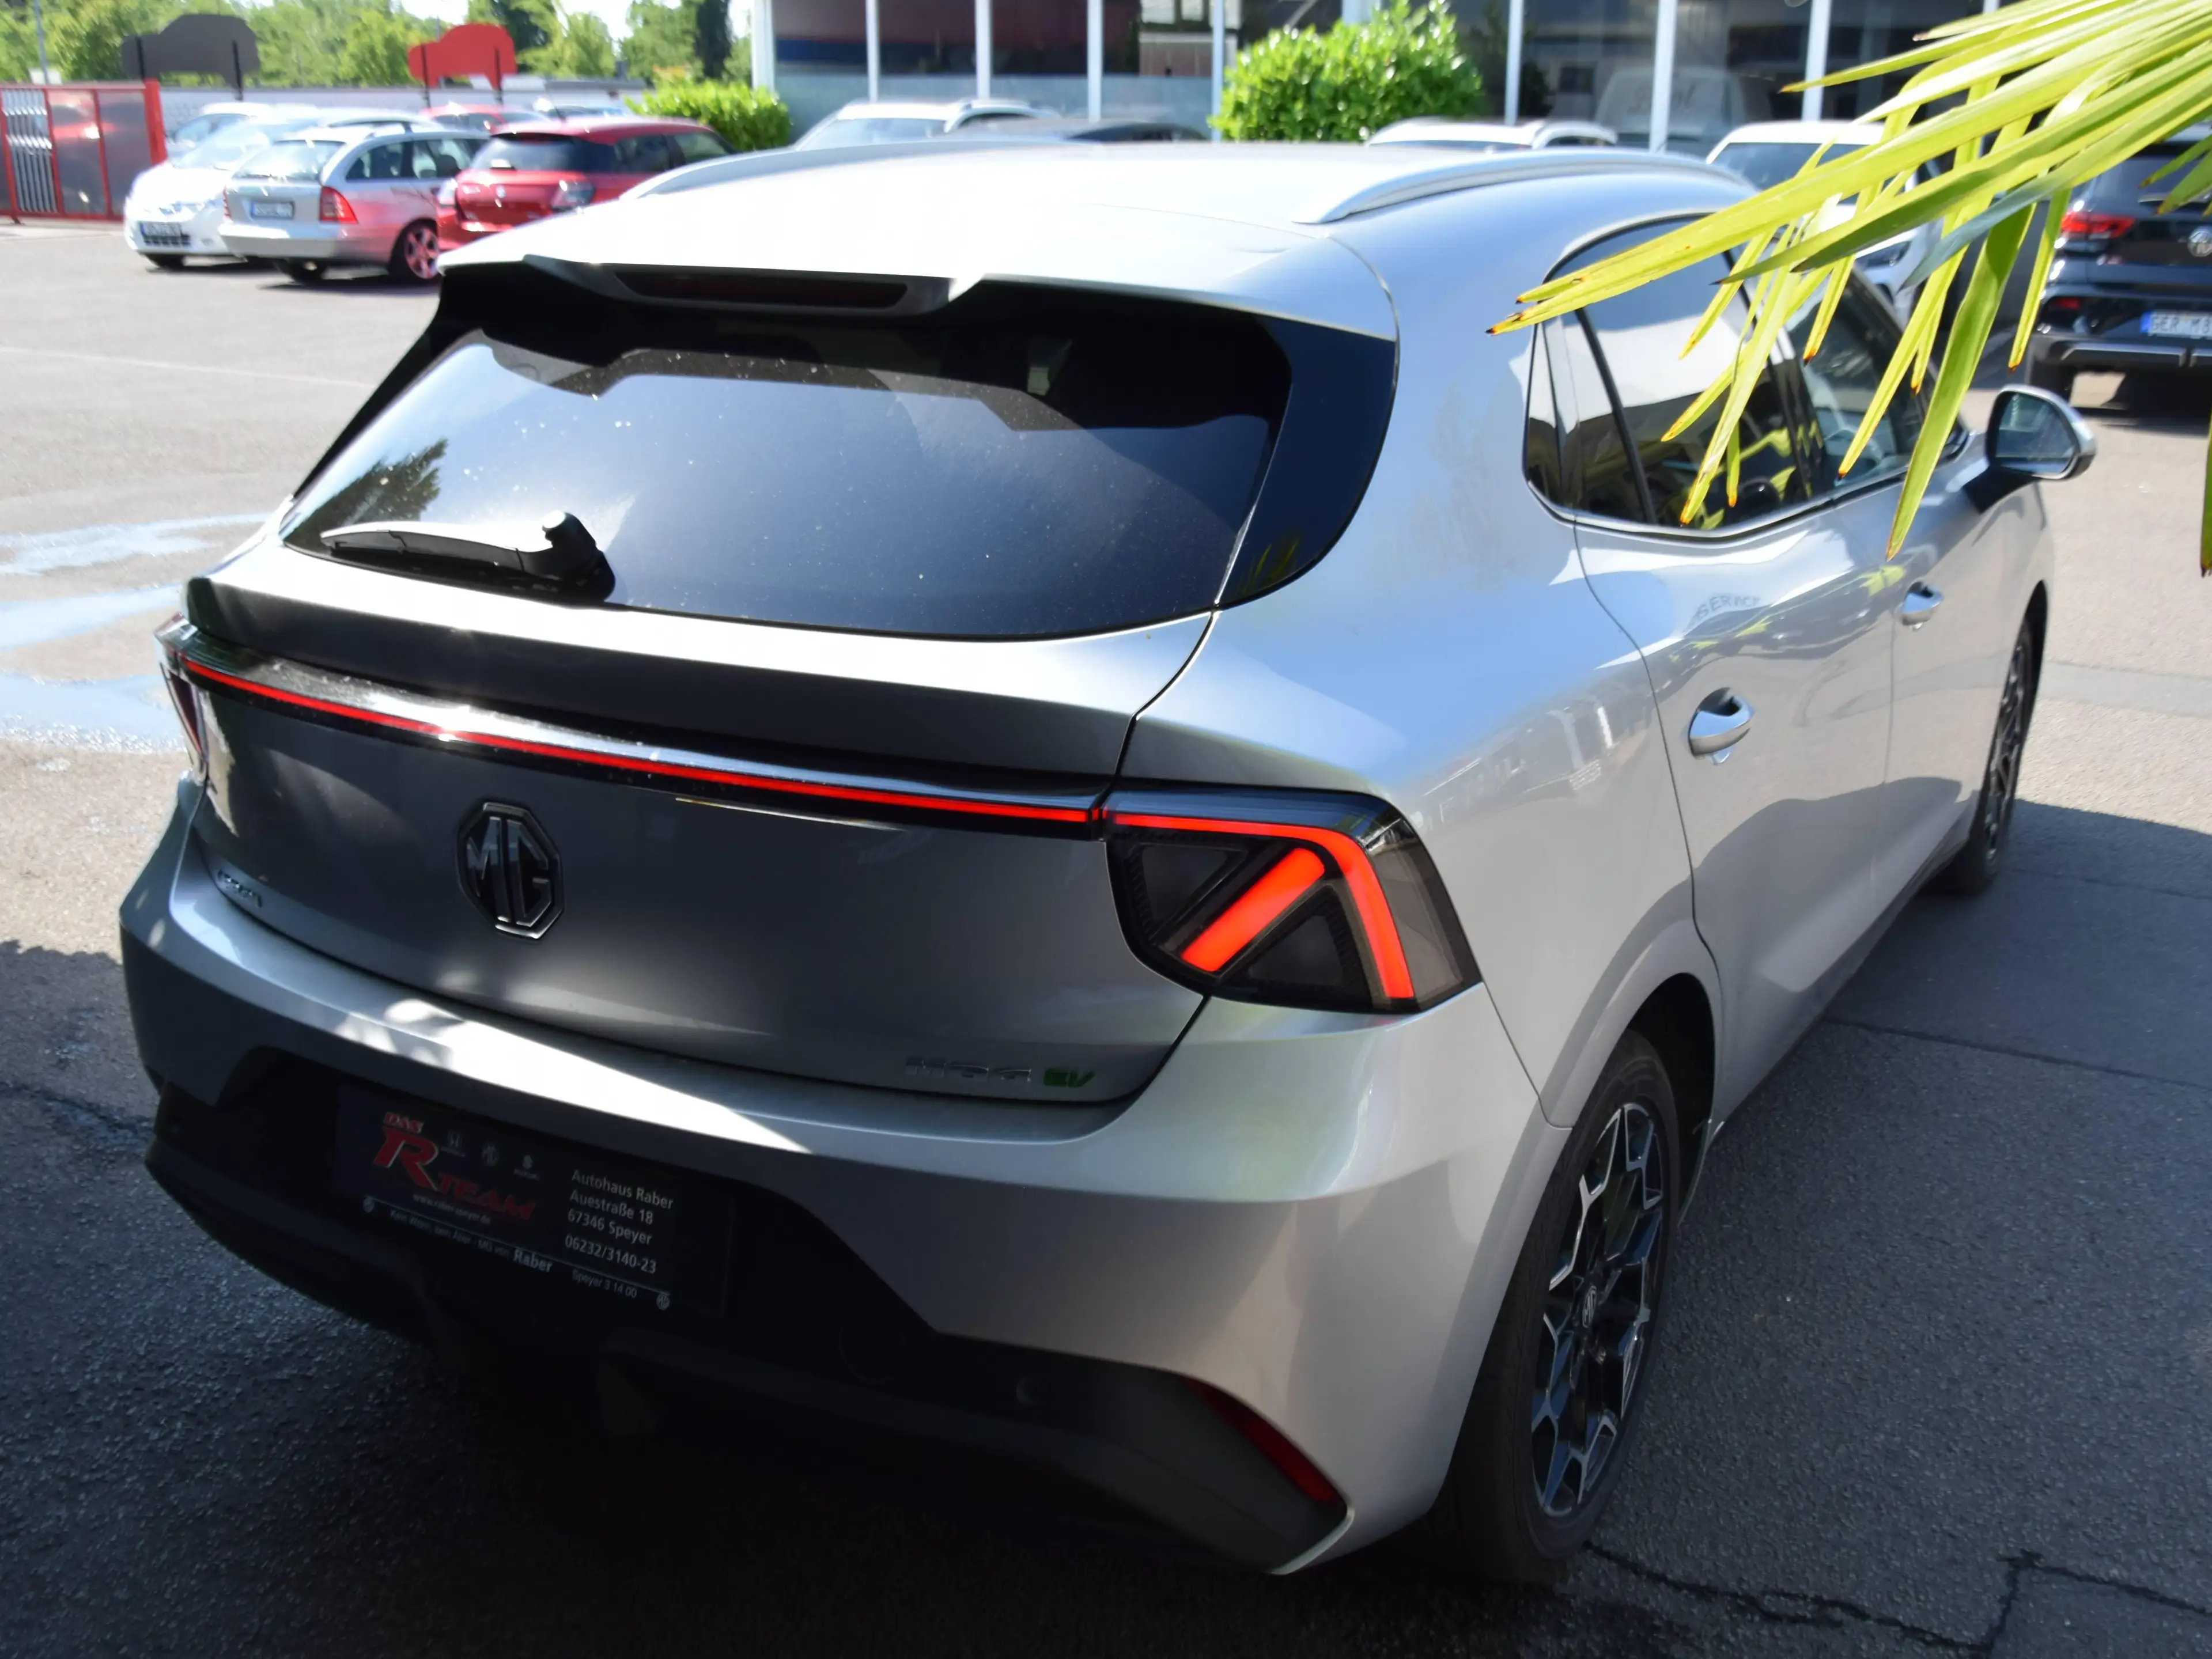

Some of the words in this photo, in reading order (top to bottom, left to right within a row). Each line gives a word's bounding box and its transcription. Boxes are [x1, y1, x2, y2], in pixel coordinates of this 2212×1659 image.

[464, 813, 554, 931] MG
[1043, 1067, 1096, 1088] EV
[383, 1111, 425, 1134] DAS
[437, 1171, 537, 1222] TEAM
[569, 1189, 635, 1219] Auestraße
[639, 1208, 655, 1225] 18
[571, 1168, 633, 1198] Autohaus
[636, 1186, 675, 1210] Raber
[567, 1208, 605, 1232] 67346
[608, 1221, 653, 1246] Speyer
[512, 1245, 554, 1274] Raber
[565, 1233, 657, 1275] 06232/3140-23
[572, 1268, 603, 1288] Speyer
[604, 1278, 611, 1290] 3
[613, 1280, 623, 1293] 14
[625, 1285, 638, 1299] 00
